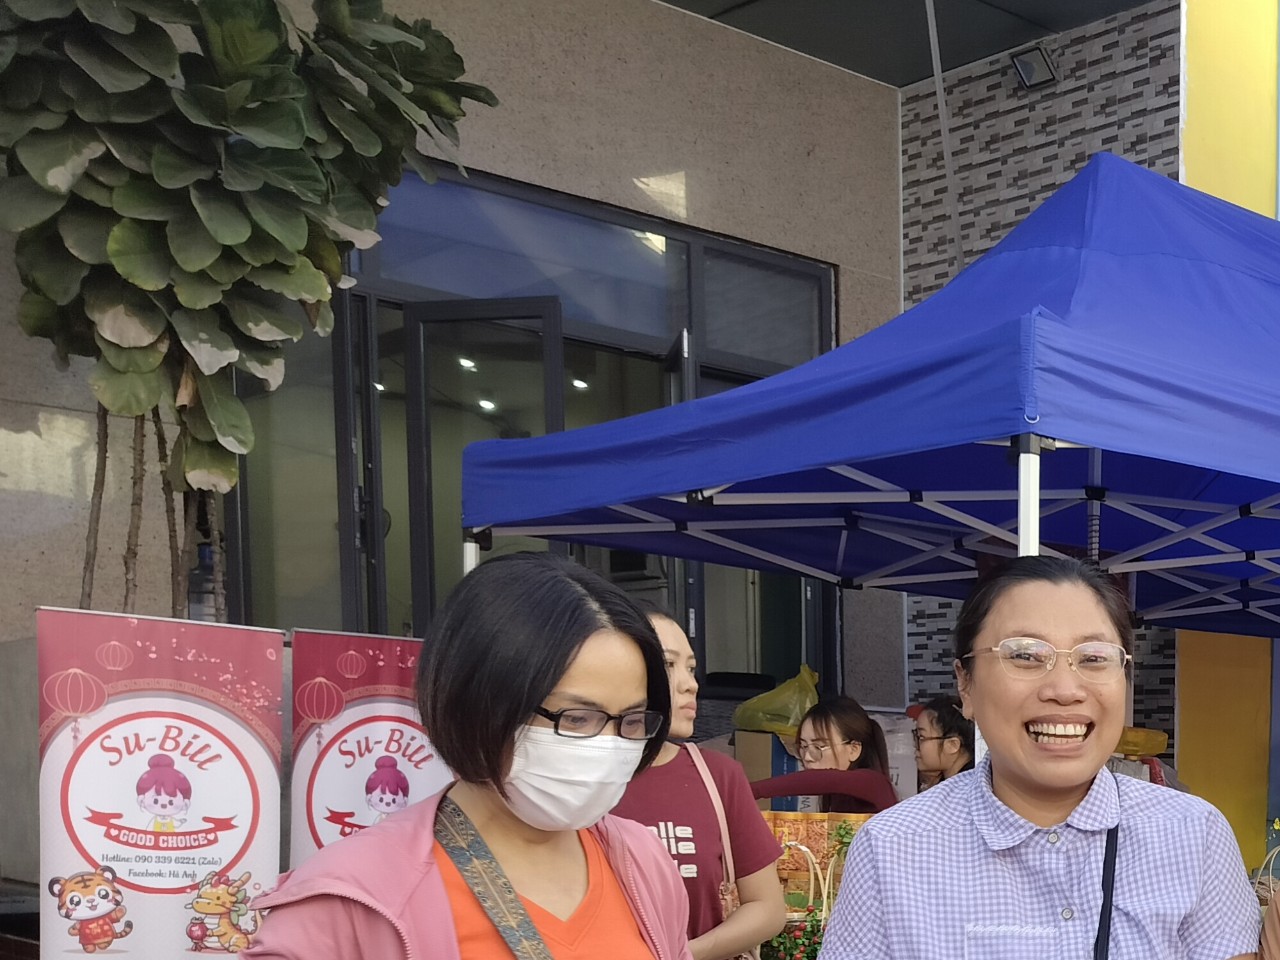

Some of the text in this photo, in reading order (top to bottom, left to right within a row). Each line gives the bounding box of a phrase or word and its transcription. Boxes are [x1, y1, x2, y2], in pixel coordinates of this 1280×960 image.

[99, 725, 223, 771] Su-Bill
[337, 728, 434, 770] Su-Bill
[119, 829, 208, 848] GOOD CHOICE
[101, 853, 133, 864] Hotline:
[134, 854, 153, 865] 090
[154, 855, 173, 865] 339
[127, 868, 168, 879] Facebook:
